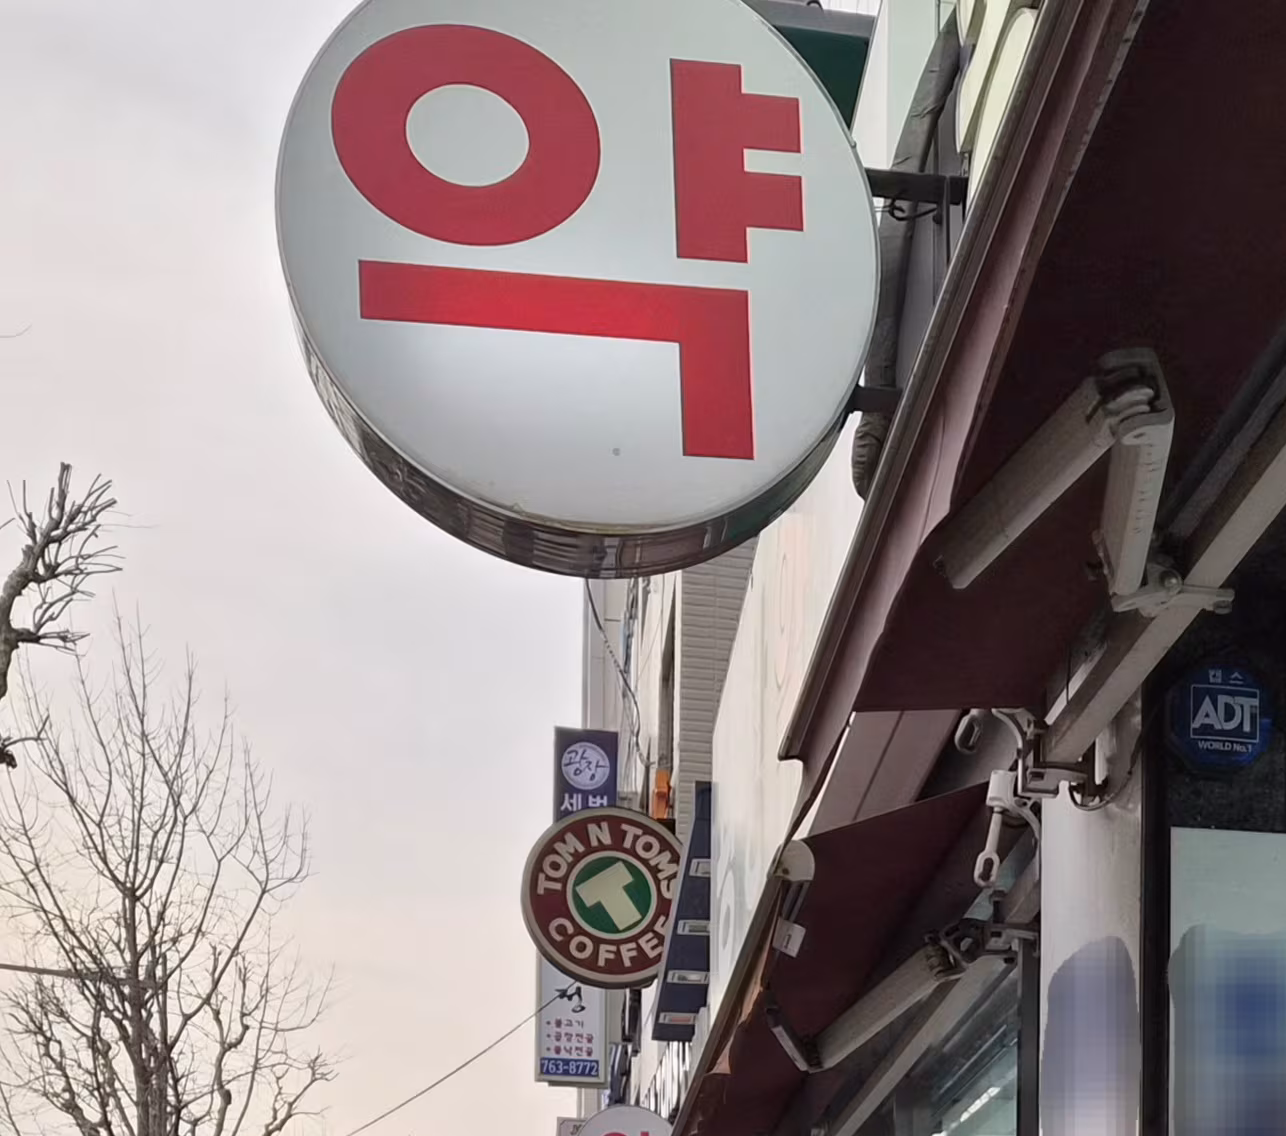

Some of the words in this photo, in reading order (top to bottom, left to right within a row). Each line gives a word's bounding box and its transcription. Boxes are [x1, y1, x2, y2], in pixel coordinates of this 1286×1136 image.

[331, 24, 804, 460] 약
[1209, 669, 1244, 684] 캡스
[1192, 694, 1259, 733] ADT
[1198, 740, 1232, 751] WORLD
[564, 748, 610, 781] 광장
[537, 833, 585, 896] TOM
[588, 820, 613, 849] N
[541, 1059, 598, 1076] 763-8772
